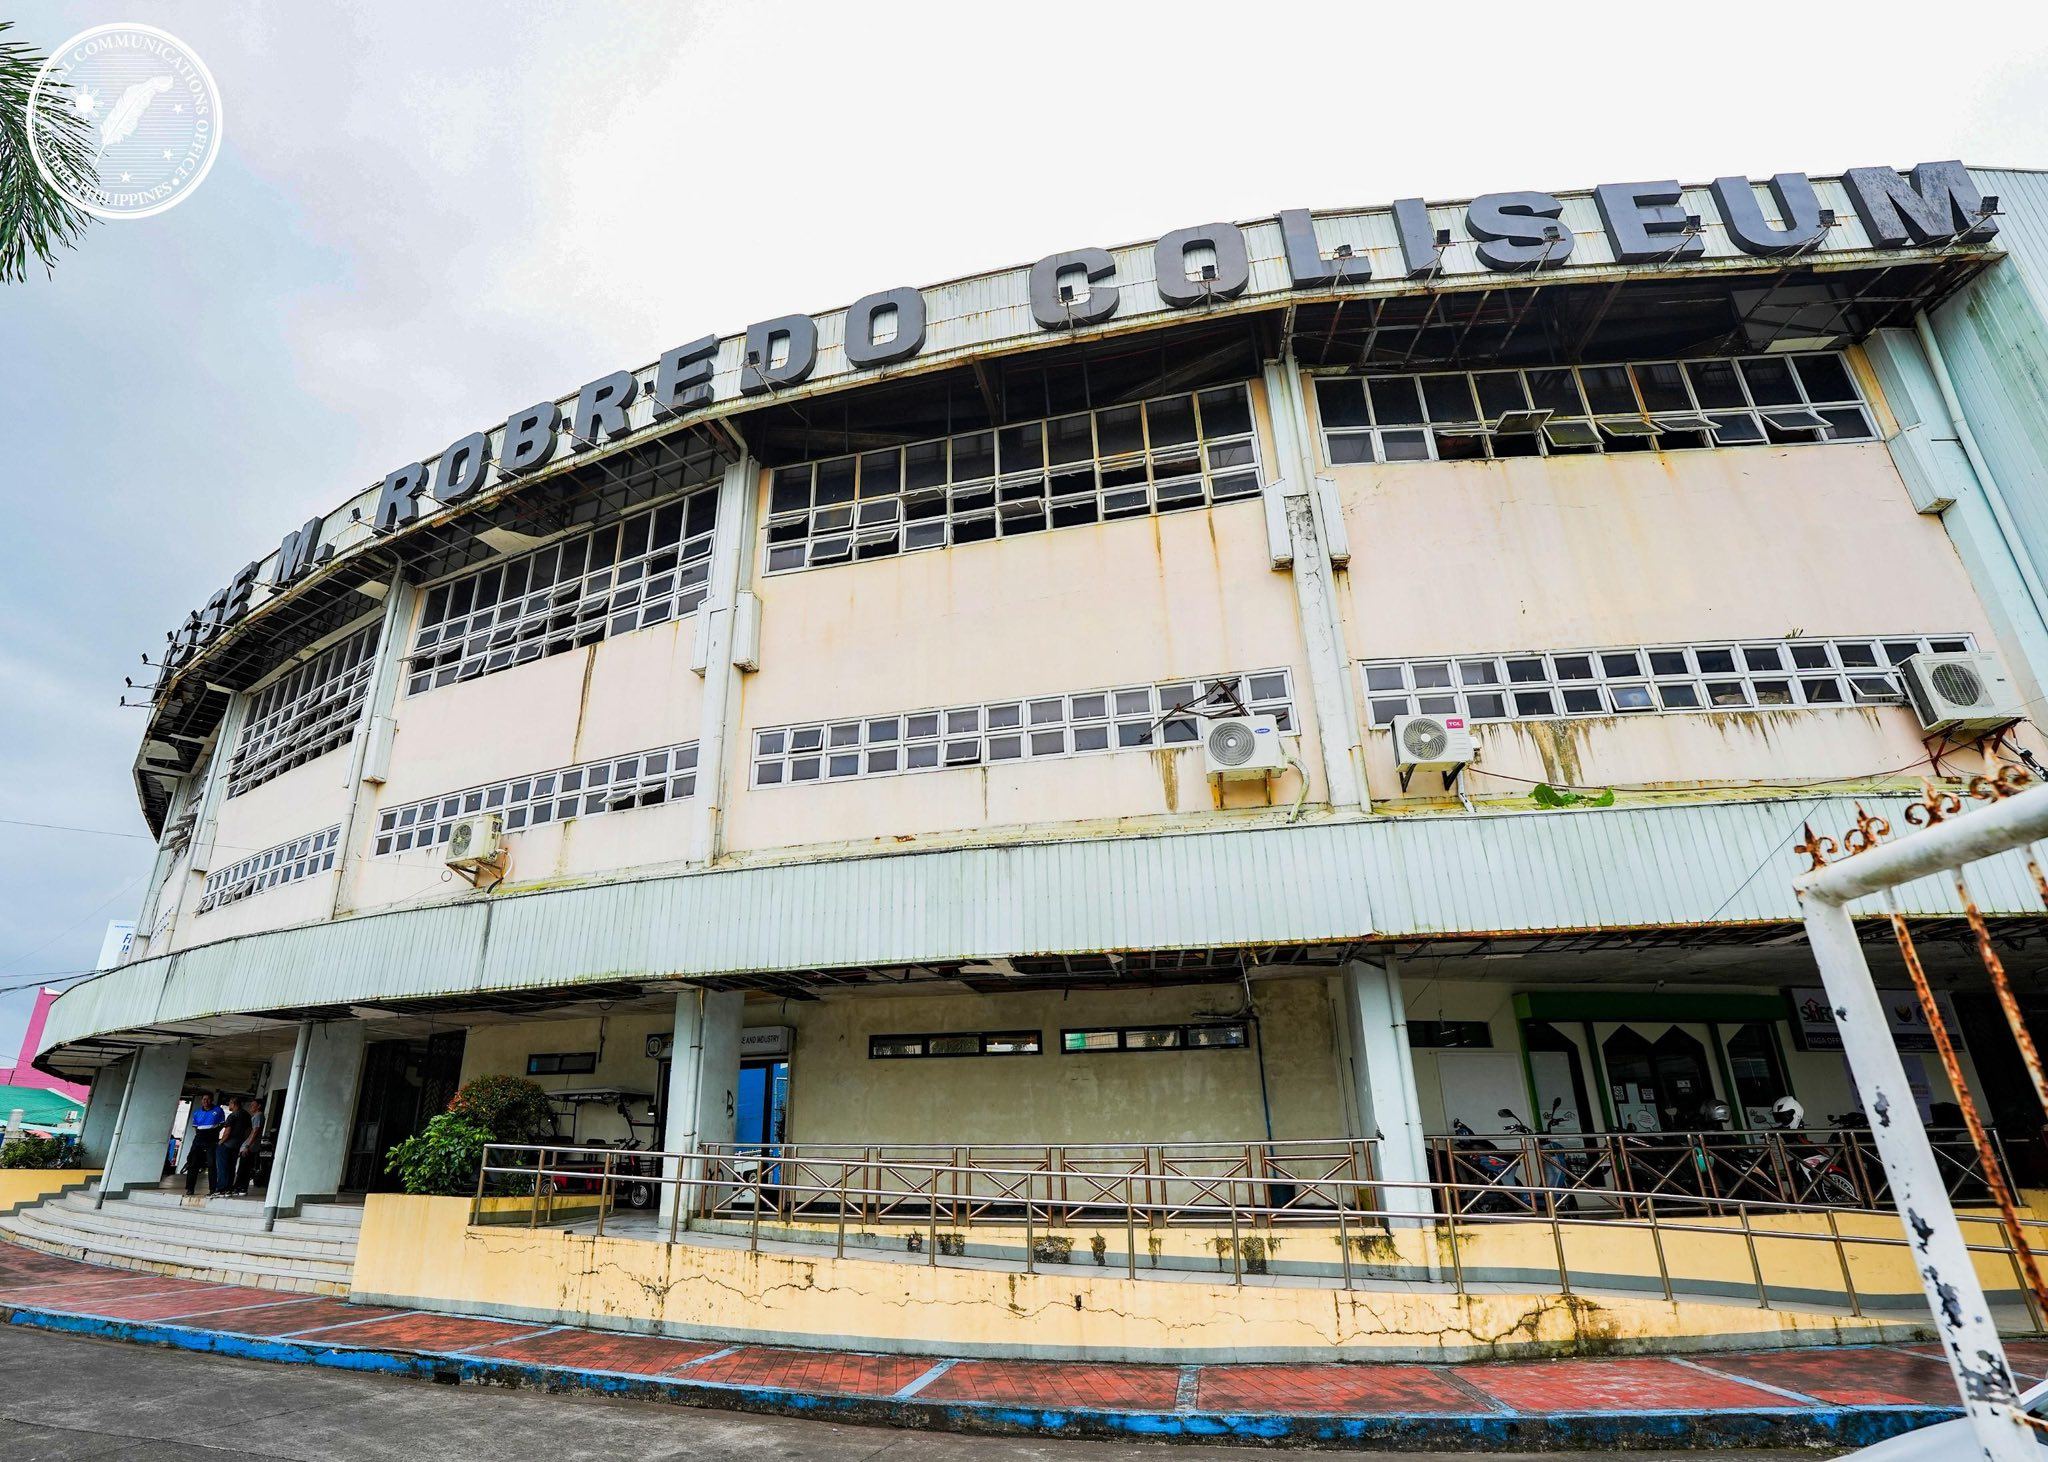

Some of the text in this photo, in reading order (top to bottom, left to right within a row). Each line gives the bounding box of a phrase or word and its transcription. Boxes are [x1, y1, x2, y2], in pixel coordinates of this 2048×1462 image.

[268, 516, 336, 595] M.
[372, 286, 927, 538] ROBREDO
[1029, 159, 2000, 330] COLISEUM
